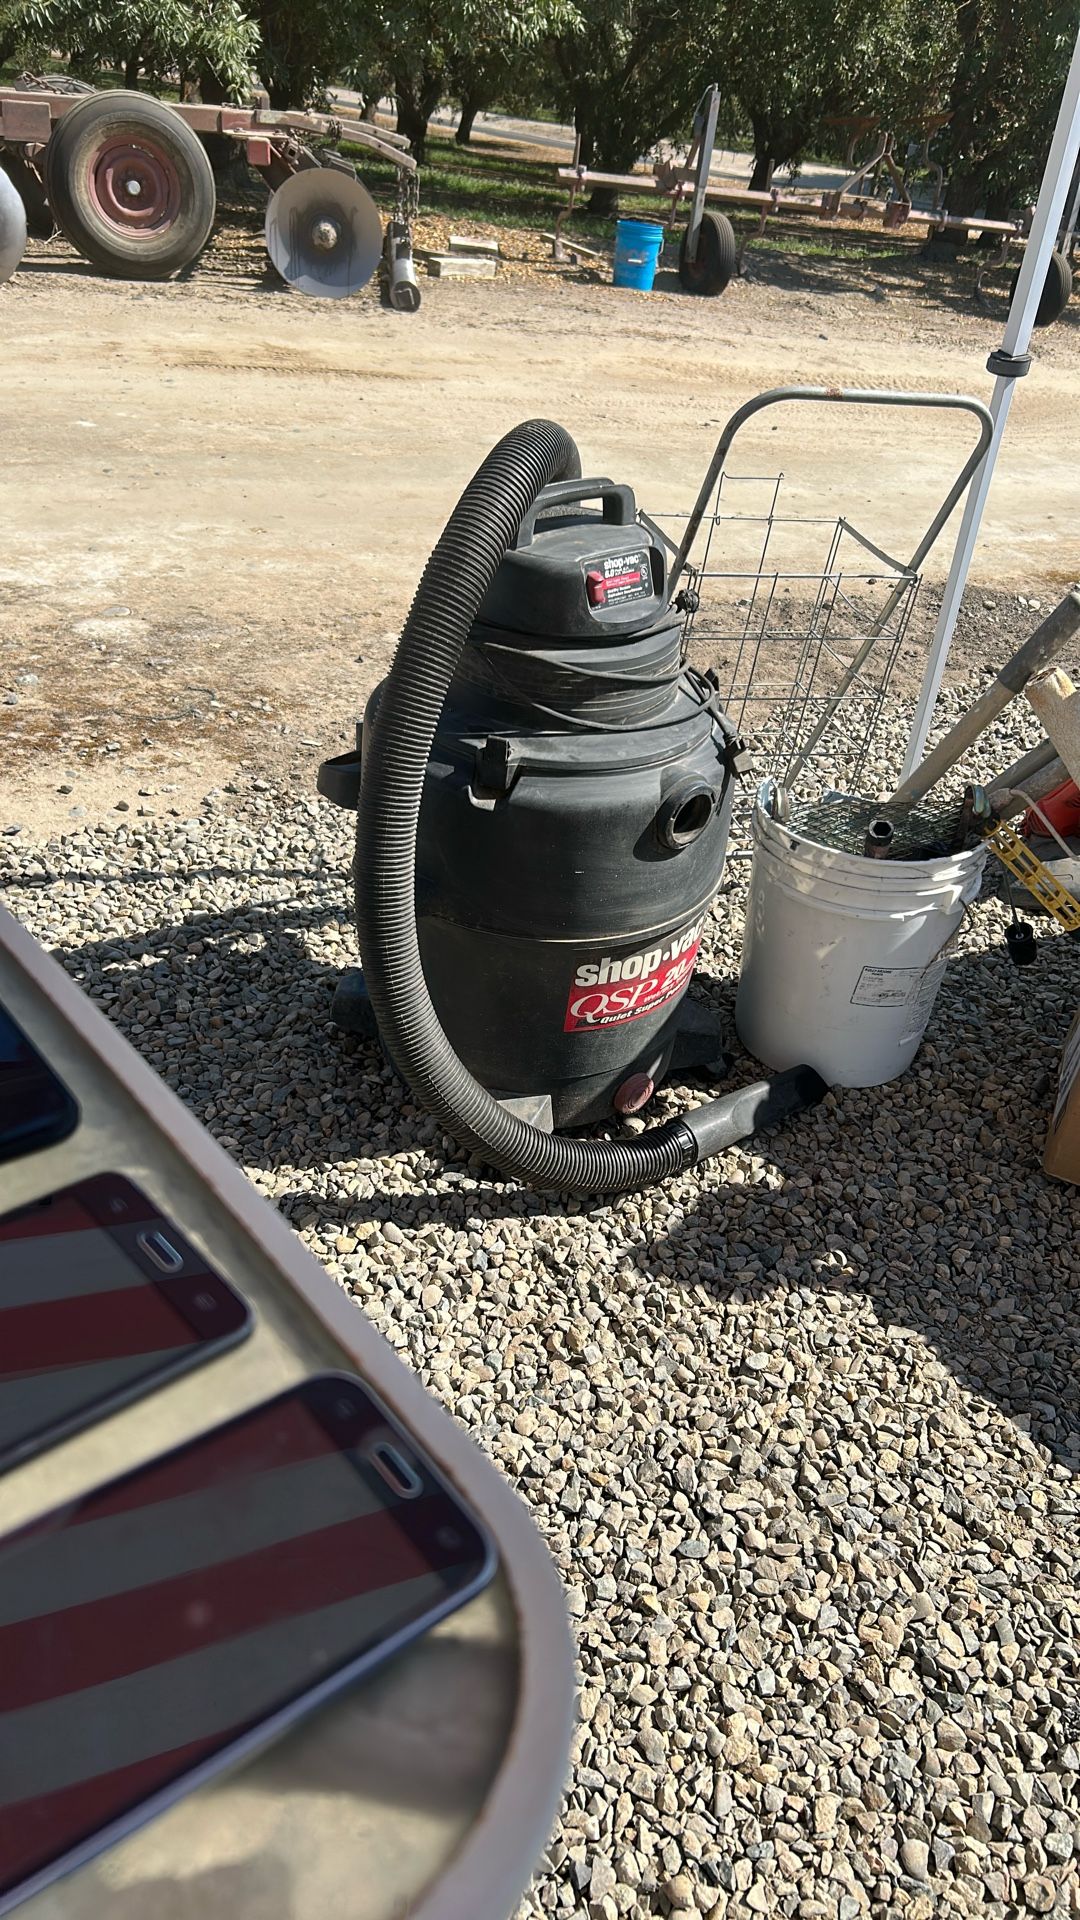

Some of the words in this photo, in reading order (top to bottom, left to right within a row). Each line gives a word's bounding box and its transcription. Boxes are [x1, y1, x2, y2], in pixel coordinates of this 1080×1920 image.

[570, 979, 658, 1024] QSP
[599, 1010, 632, 1024] Quiet
[634, 996, 665, 1015] Super
